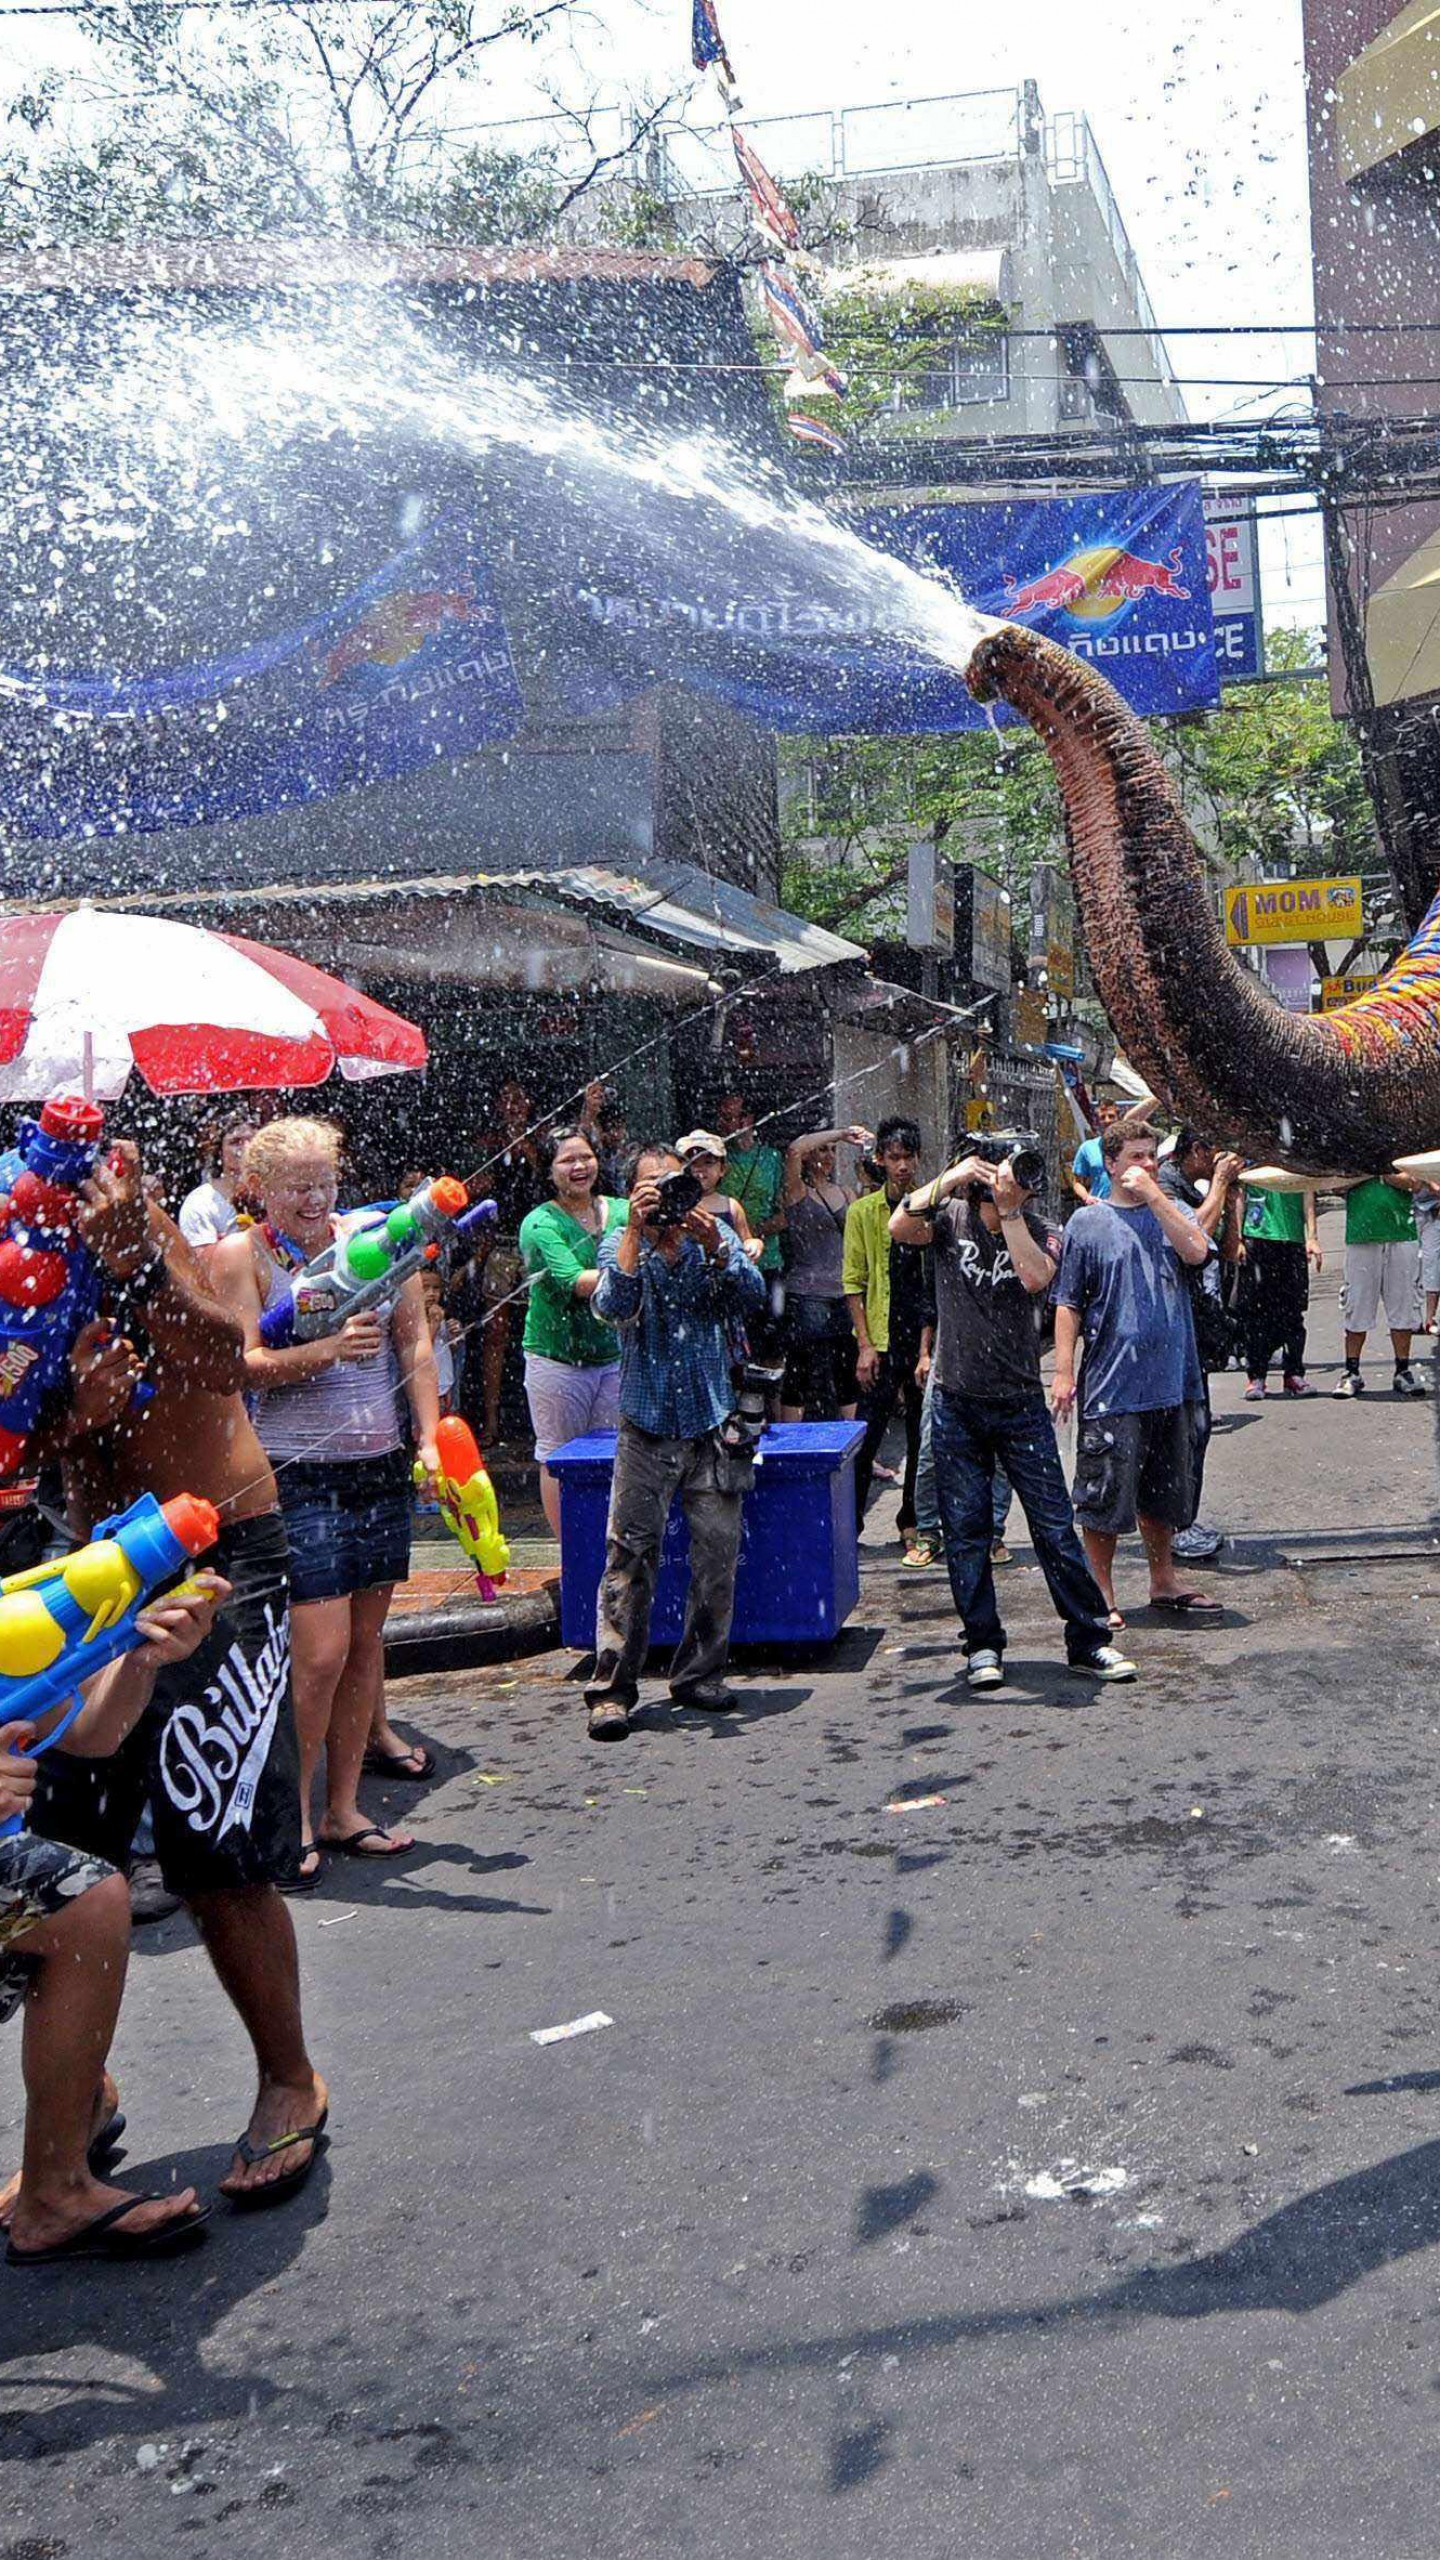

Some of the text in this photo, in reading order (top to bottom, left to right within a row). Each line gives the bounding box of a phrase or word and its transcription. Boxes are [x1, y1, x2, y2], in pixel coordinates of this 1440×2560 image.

[1255, 889, 1321, 914] MOM
[1306, 910, 1356, 923] HOUSE
[958, 1239, 1018, 1287] Ray-Ba
